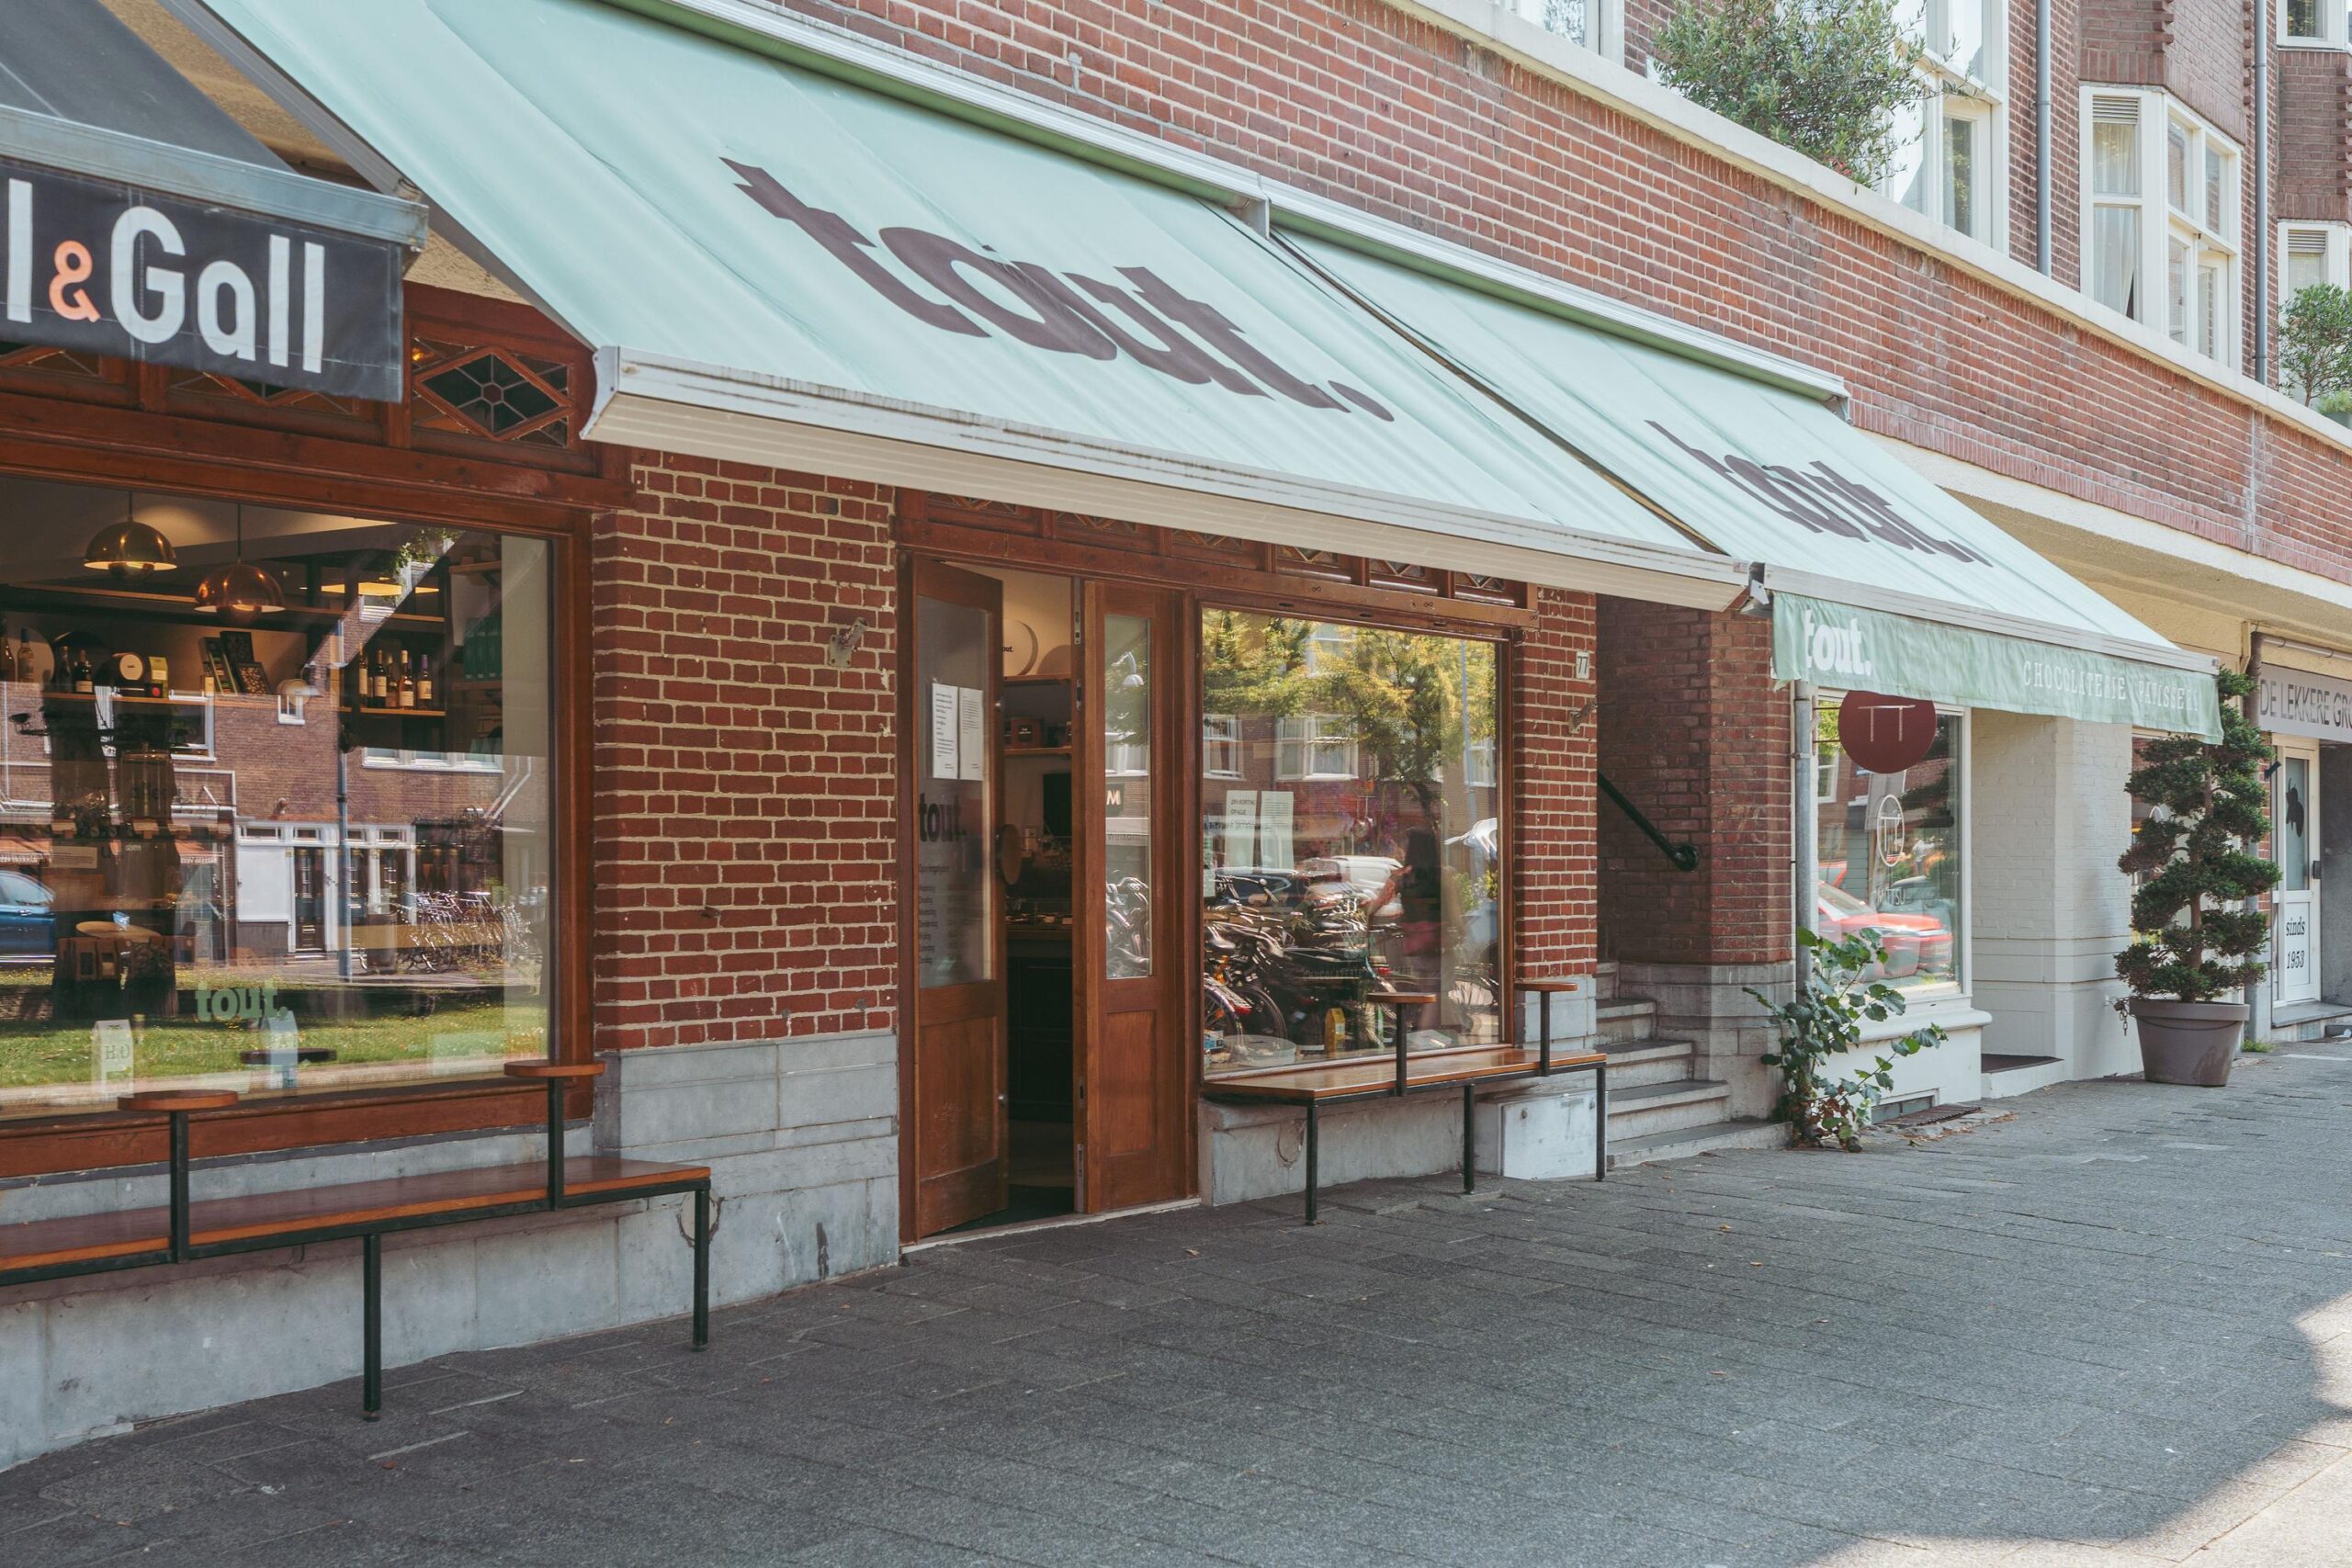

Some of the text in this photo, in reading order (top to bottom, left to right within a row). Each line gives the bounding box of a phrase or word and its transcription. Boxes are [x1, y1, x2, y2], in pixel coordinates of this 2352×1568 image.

[1577, 656, 1589, 675] 77
[2260, 679, 2277, 716] DE
[2280, 682, 2330, 726] LEKKERE
[2286, 916, 2305, 936] sinds
[195, 979, 288, 1022] tout.
